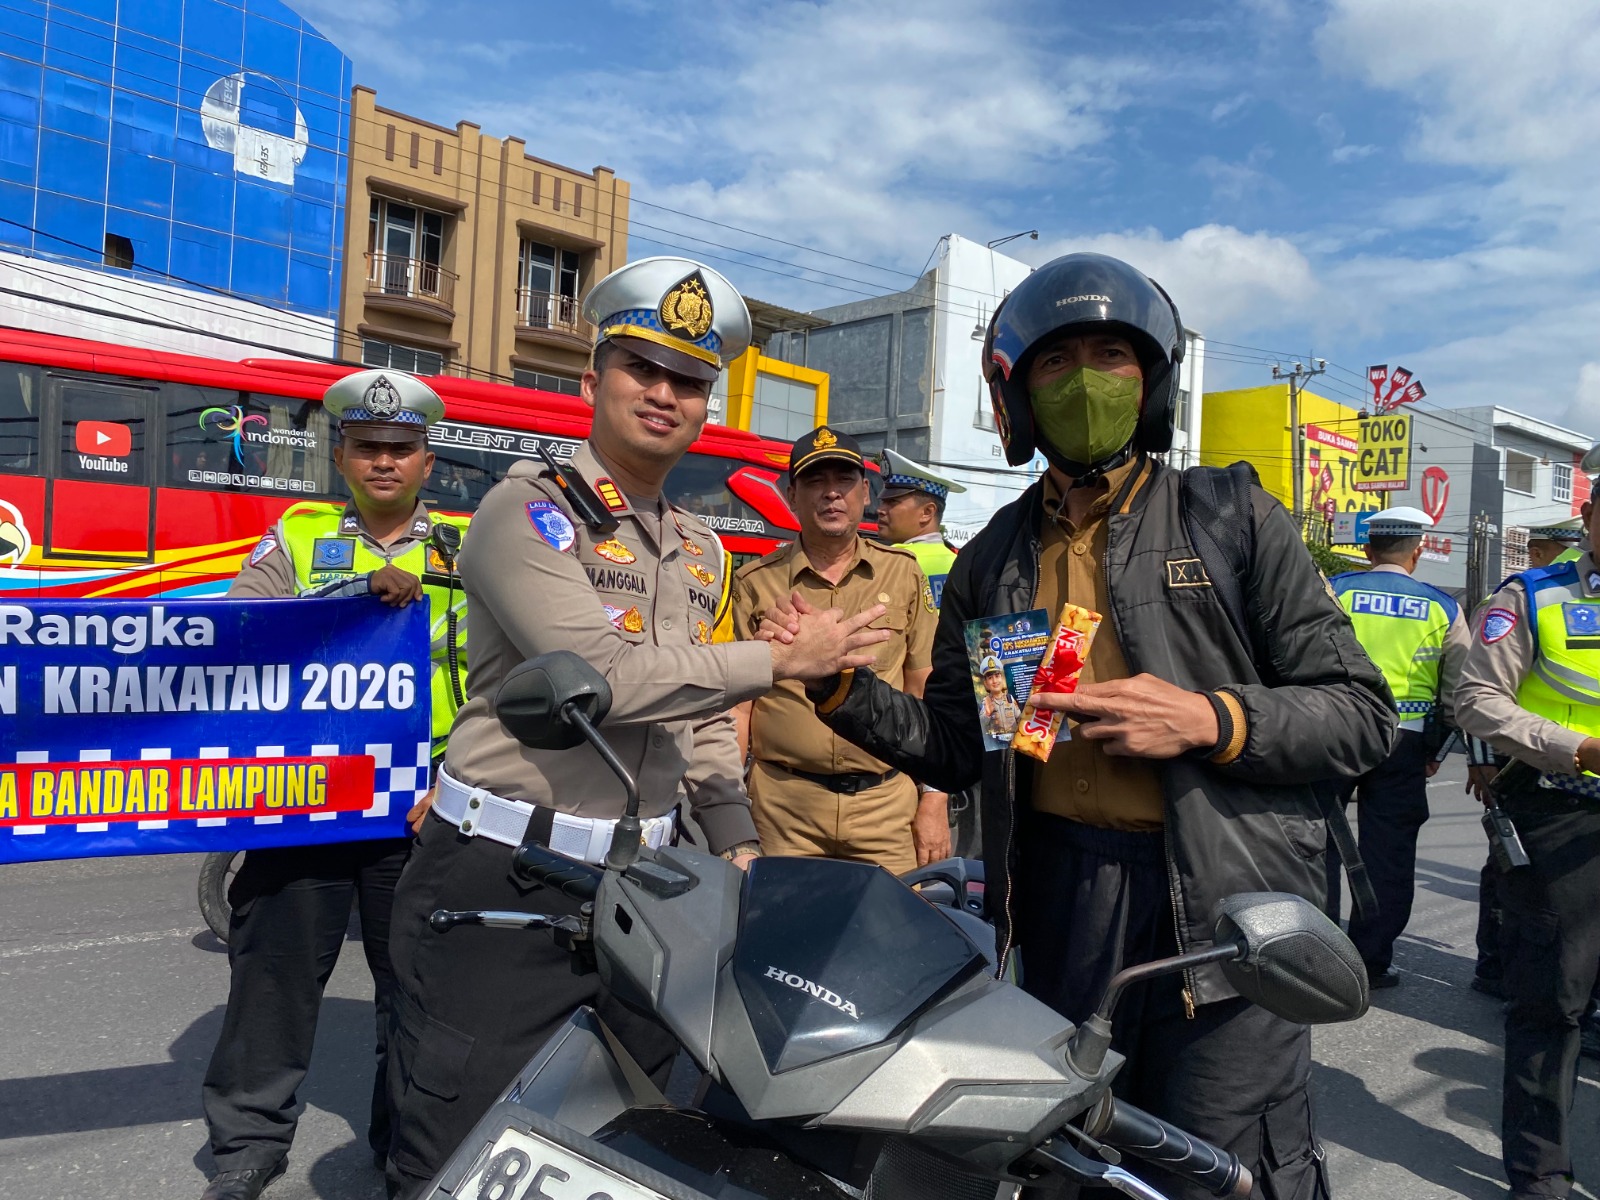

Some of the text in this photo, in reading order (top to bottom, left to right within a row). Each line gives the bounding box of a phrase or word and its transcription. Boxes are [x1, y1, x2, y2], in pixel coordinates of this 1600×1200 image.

[1055, 294, 1113, 307] HONDA
[1371, 370, 1386, 380] WA
[1394, 371, 1407, 386] WA
[272, 427, 316, 438] wonderful
[428, 425, 514, 449] ELLENT
[1317, 430, 1336, 445] BUKA
[1360, 419, 1406, 443] TOKO
[79, 455, 128, 472] YouTube
[1360, 447, 1404, 477] CAT
[1354, 593, 1428, 618] POLISI
[0, 604, 215, 654] Rangka
[44, 664, 290, 714] KRAKATAU
[301, 662, 415, 710] 2026
[32, 769, 169, 817] BANDAR
[181, 764, 326, 811] LAMPUNG
[764, 965, 859, 1020] HONDA
